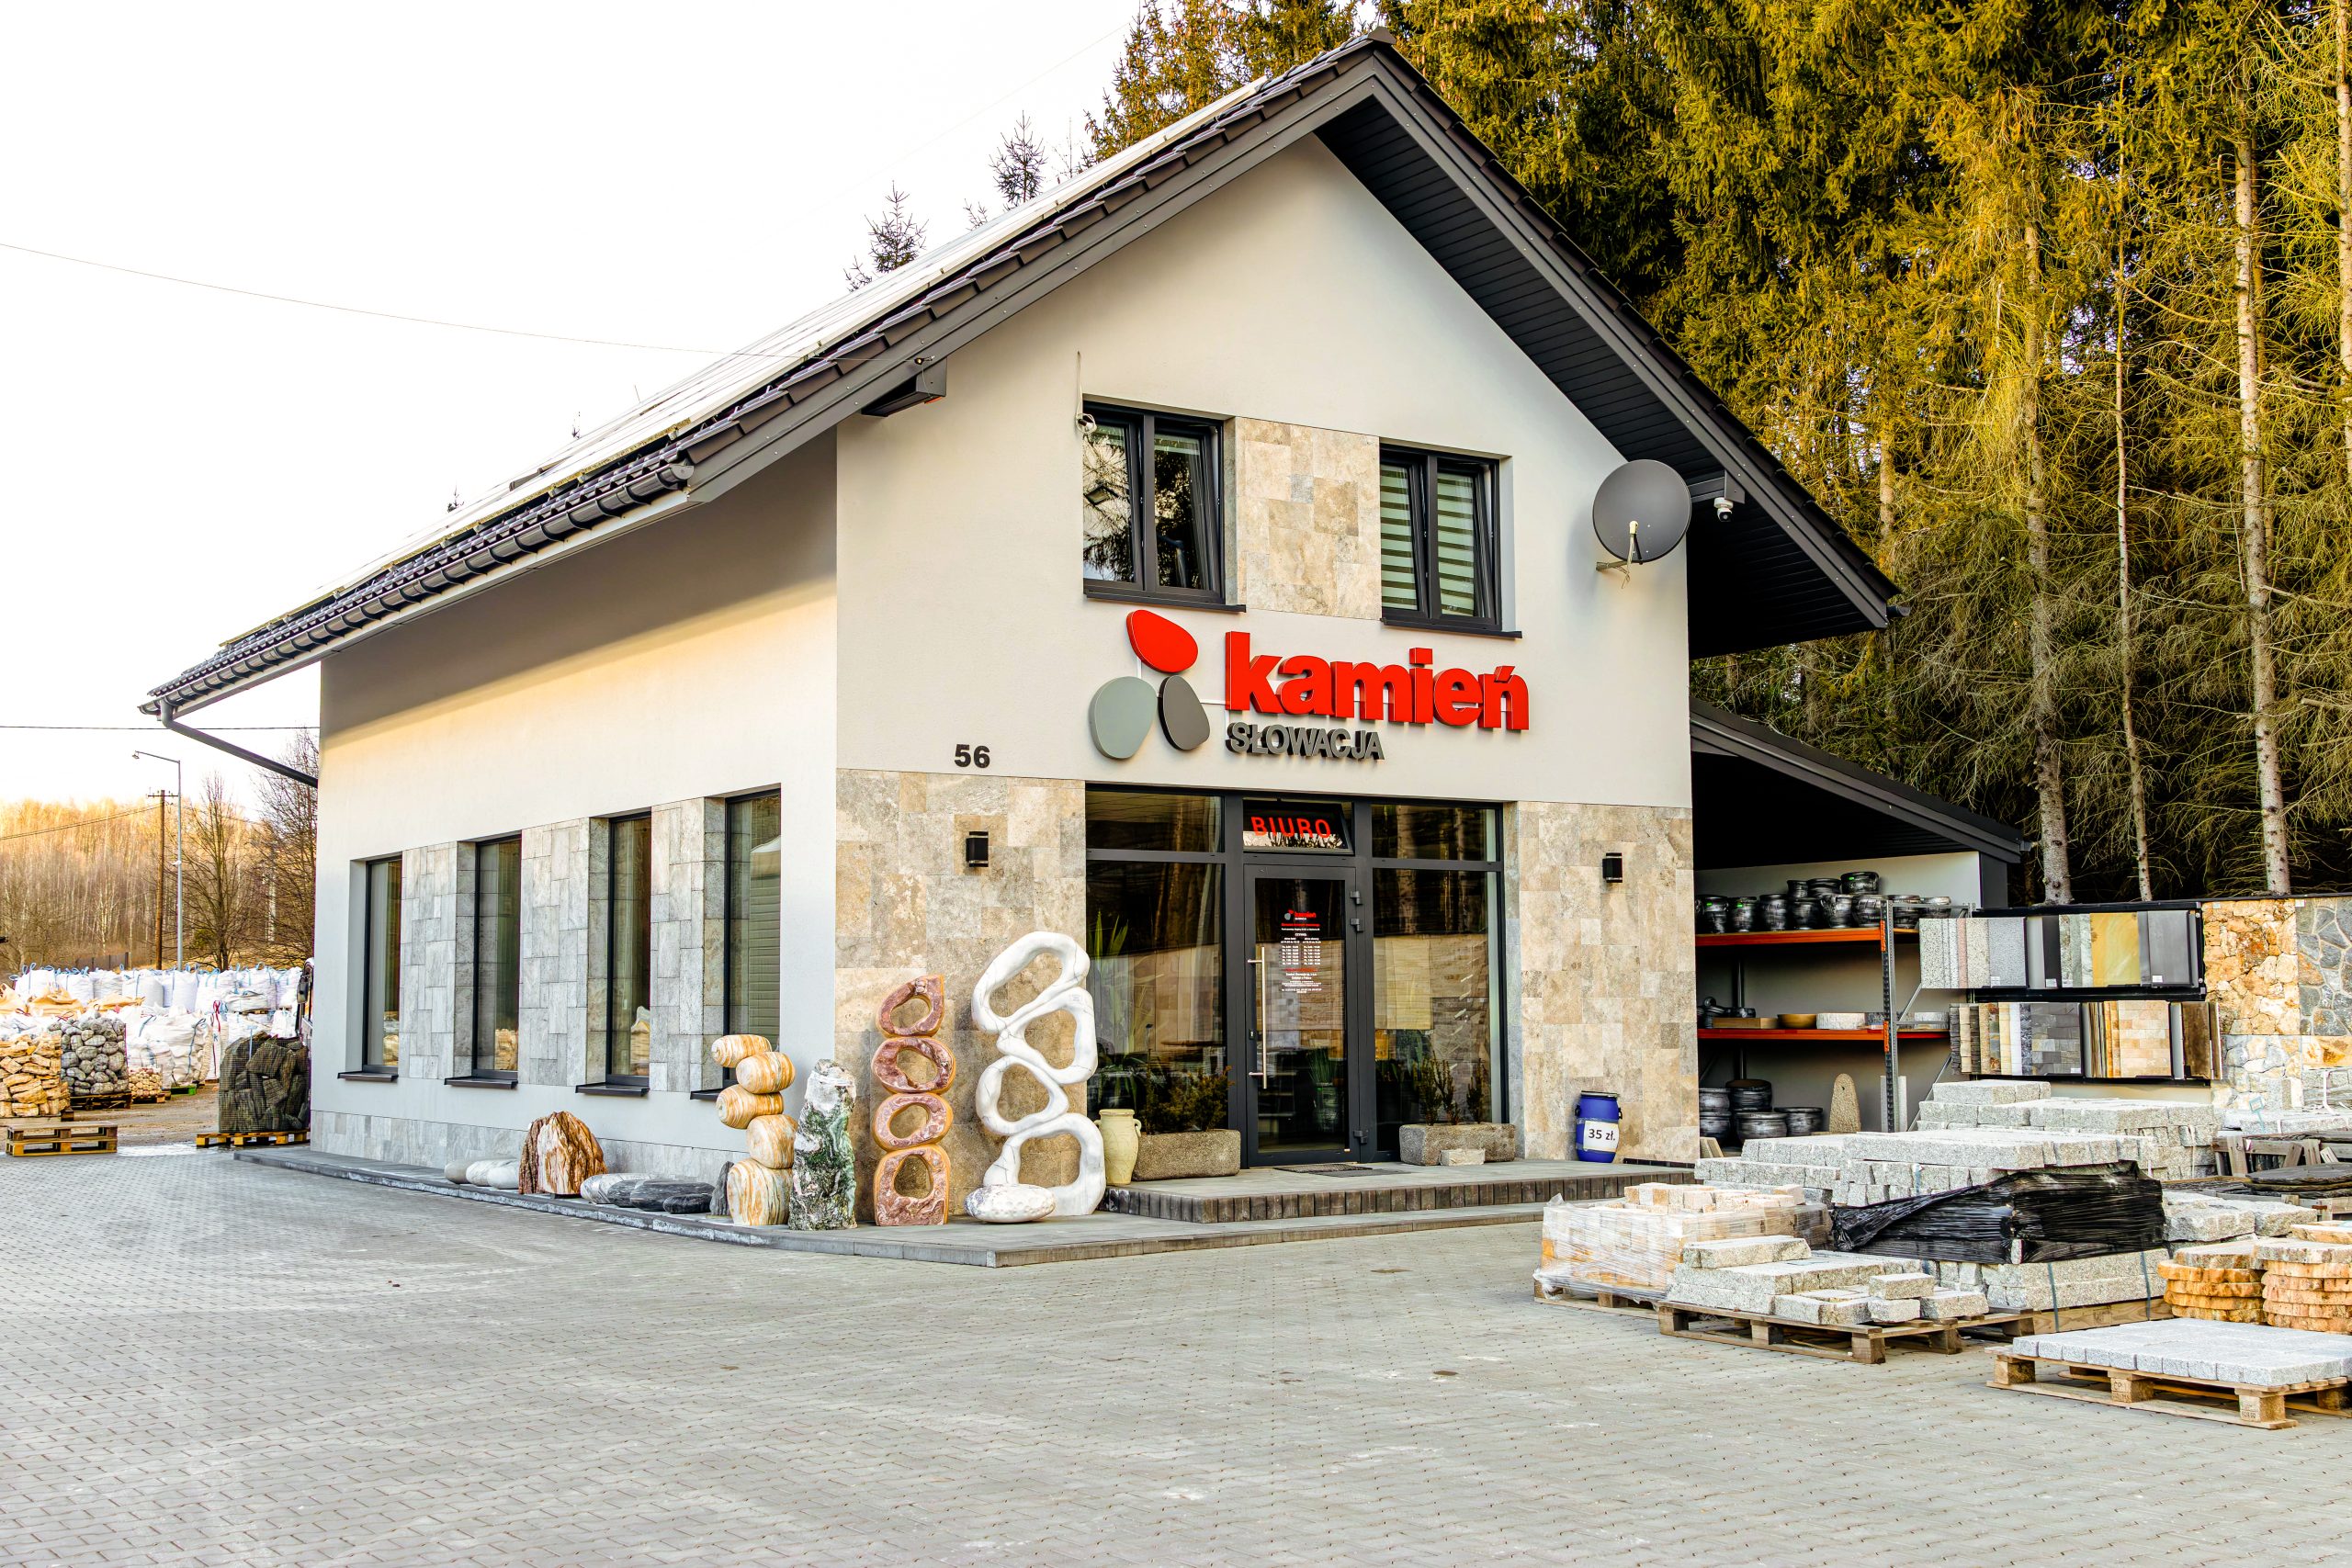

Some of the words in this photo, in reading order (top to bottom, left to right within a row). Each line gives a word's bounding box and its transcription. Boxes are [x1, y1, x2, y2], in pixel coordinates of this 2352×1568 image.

[1226, 631, 1529, 730] kamień
[1226, 721, 1385, 761] SŁOWACJA
[955, 743, 990, 769] 56
[1250, 816, 1331, 839] BIURO
[1589, 1128, 1602, 1140] 35
[1605, 1130, 1616, 1141] zł.
